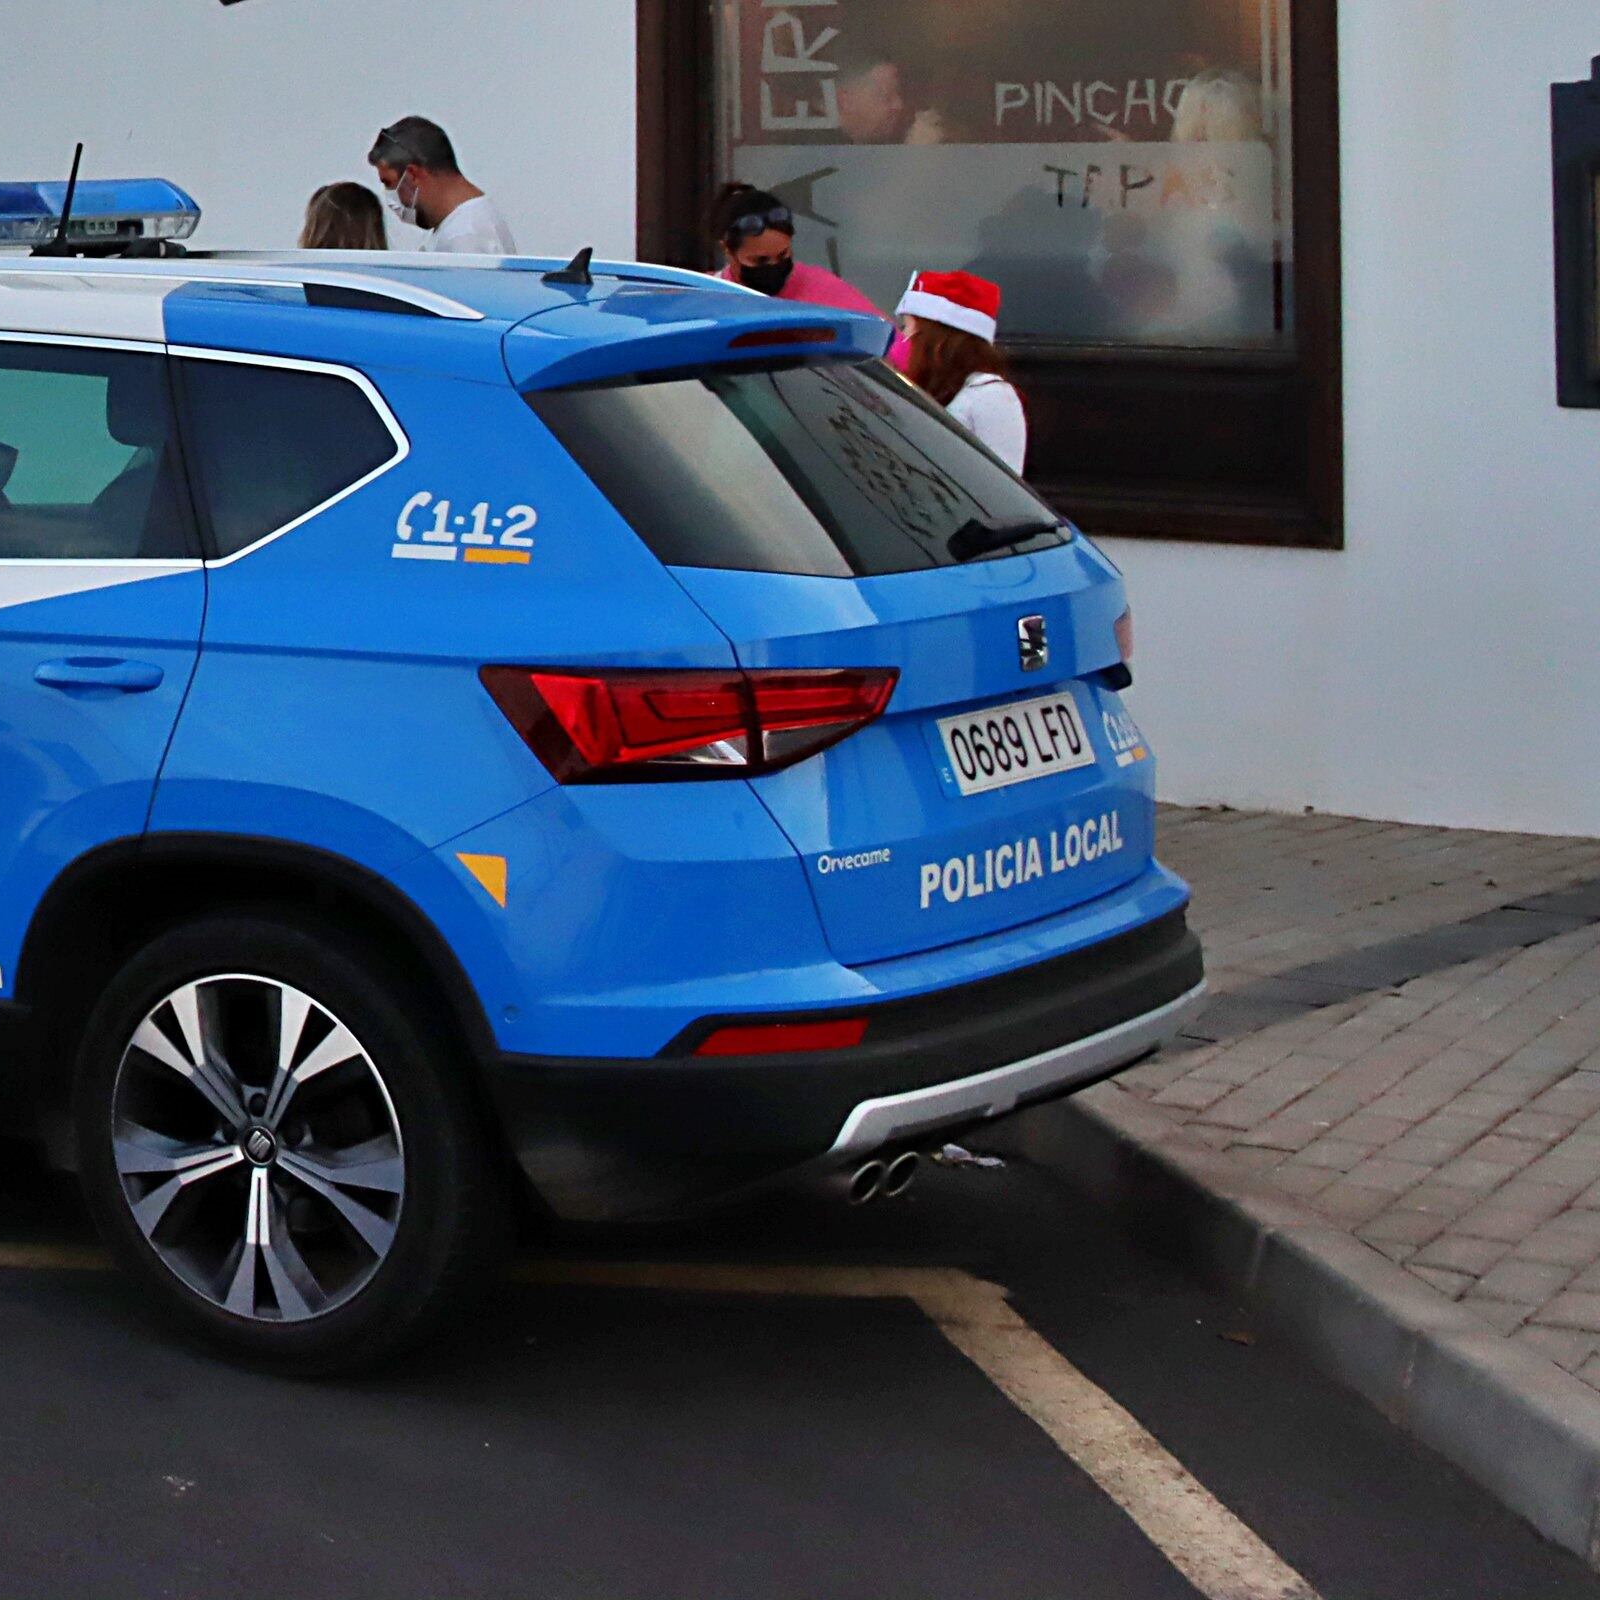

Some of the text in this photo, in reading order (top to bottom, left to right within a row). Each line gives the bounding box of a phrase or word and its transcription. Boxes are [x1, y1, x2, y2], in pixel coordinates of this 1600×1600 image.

[950, 716, 1029, 781] 0689
[1025, 703, 1082, 763] LFD
[817, 847, 891, 875] Orvecame
[920, 810, 1123, 909] POLICIA LOCAL
